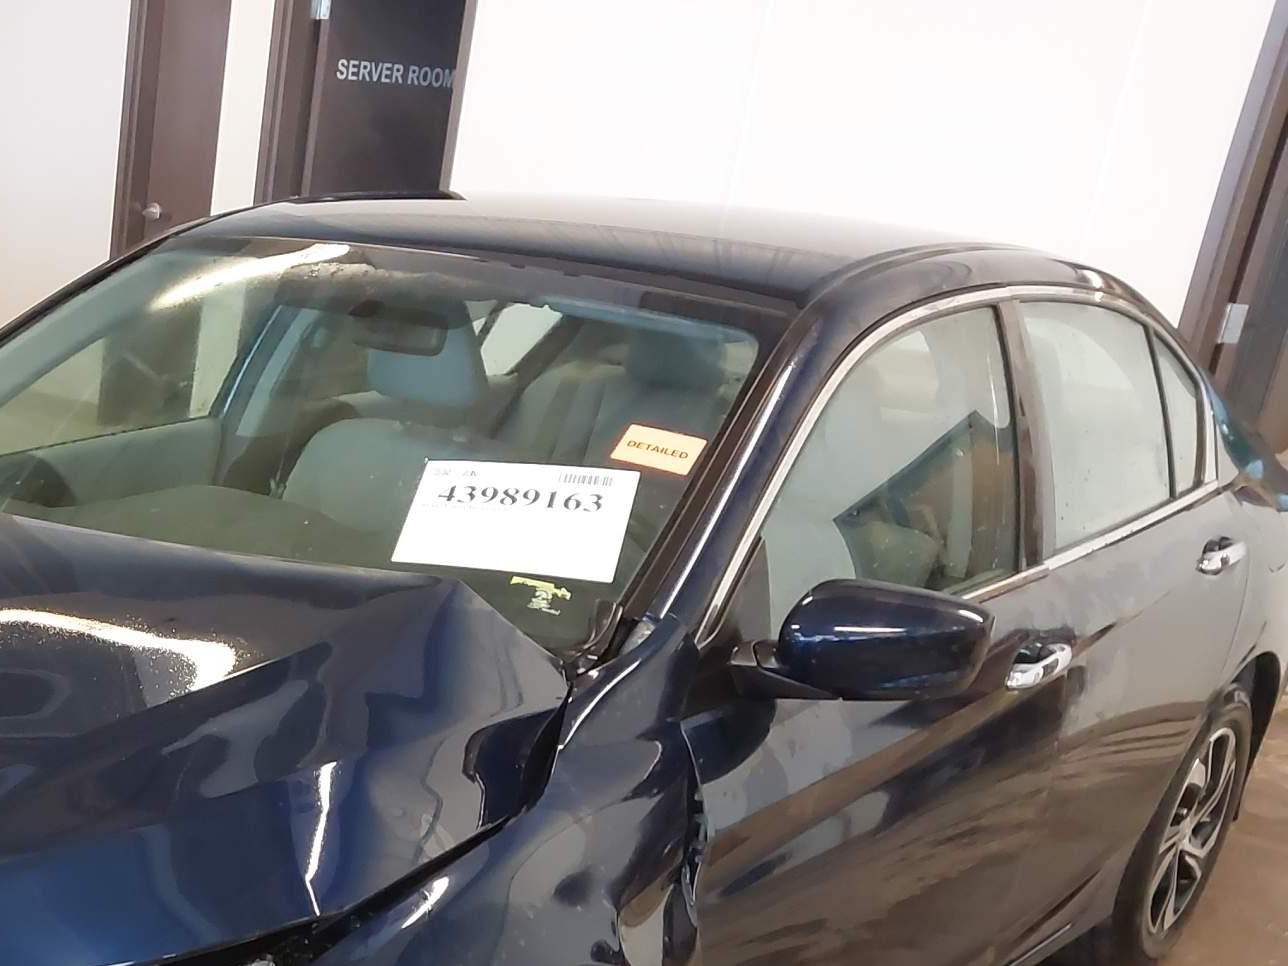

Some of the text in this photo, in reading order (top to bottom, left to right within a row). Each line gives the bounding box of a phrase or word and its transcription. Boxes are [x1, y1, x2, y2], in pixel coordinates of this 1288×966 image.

[336, 59, 404, 84] SERVER
[626, 440, 689, 459] DETAILED
[438, 485, 604, 512] 43989163
